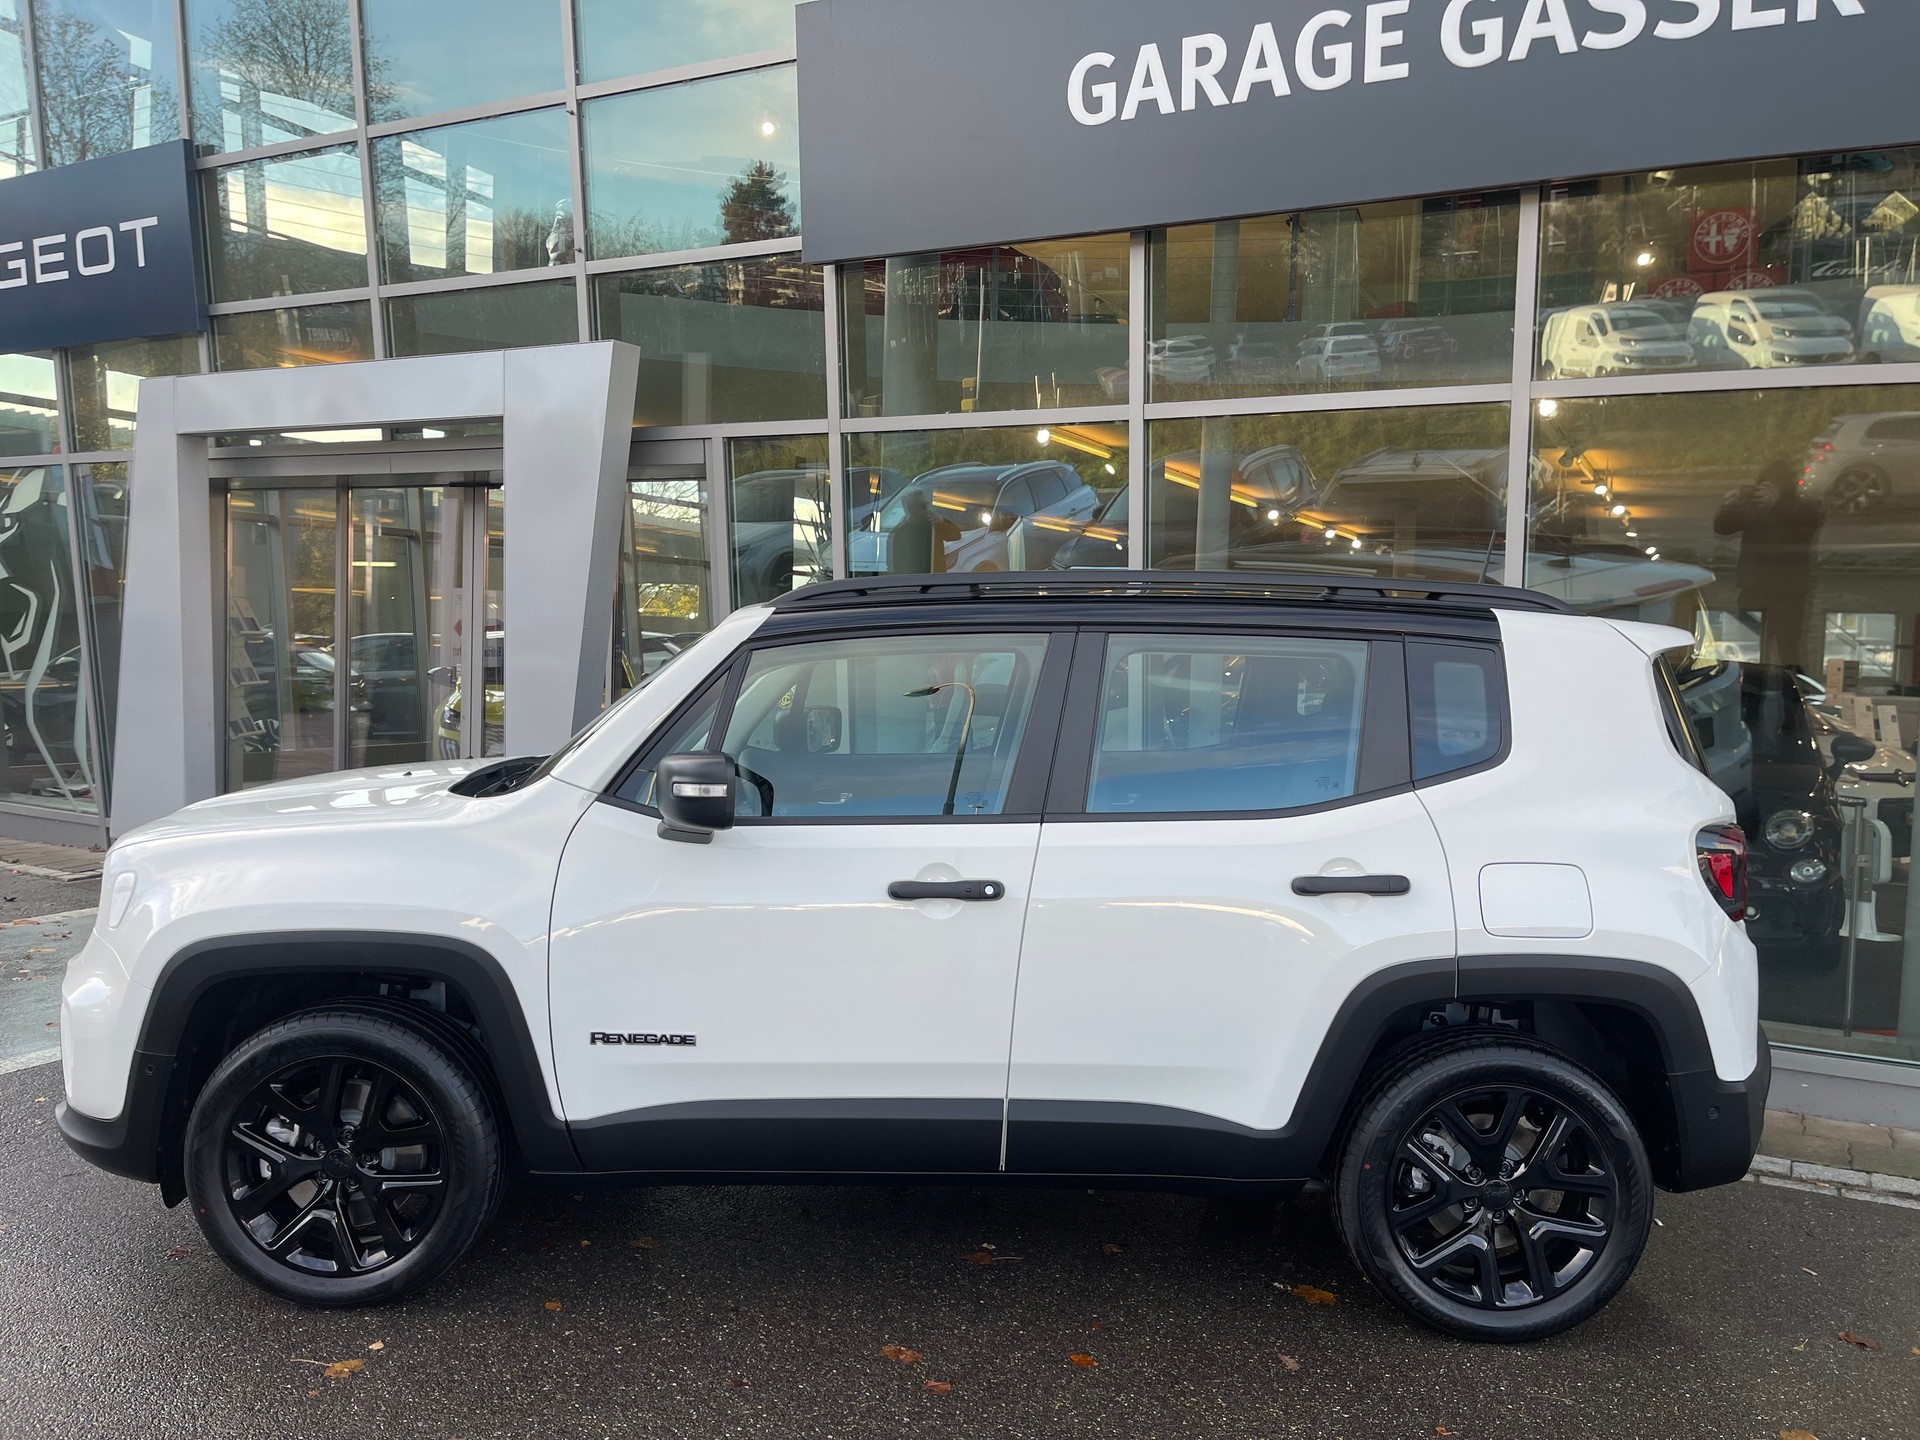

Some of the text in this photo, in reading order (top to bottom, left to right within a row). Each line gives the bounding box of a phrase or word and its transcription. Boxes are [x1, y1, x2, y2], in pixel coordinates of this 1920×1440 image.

[1067, 0, 1865, 126] GARAGE GAS
[0, 216, 158, 289] GEOT
[590, 1032, 696, 1046] RENEGADE
